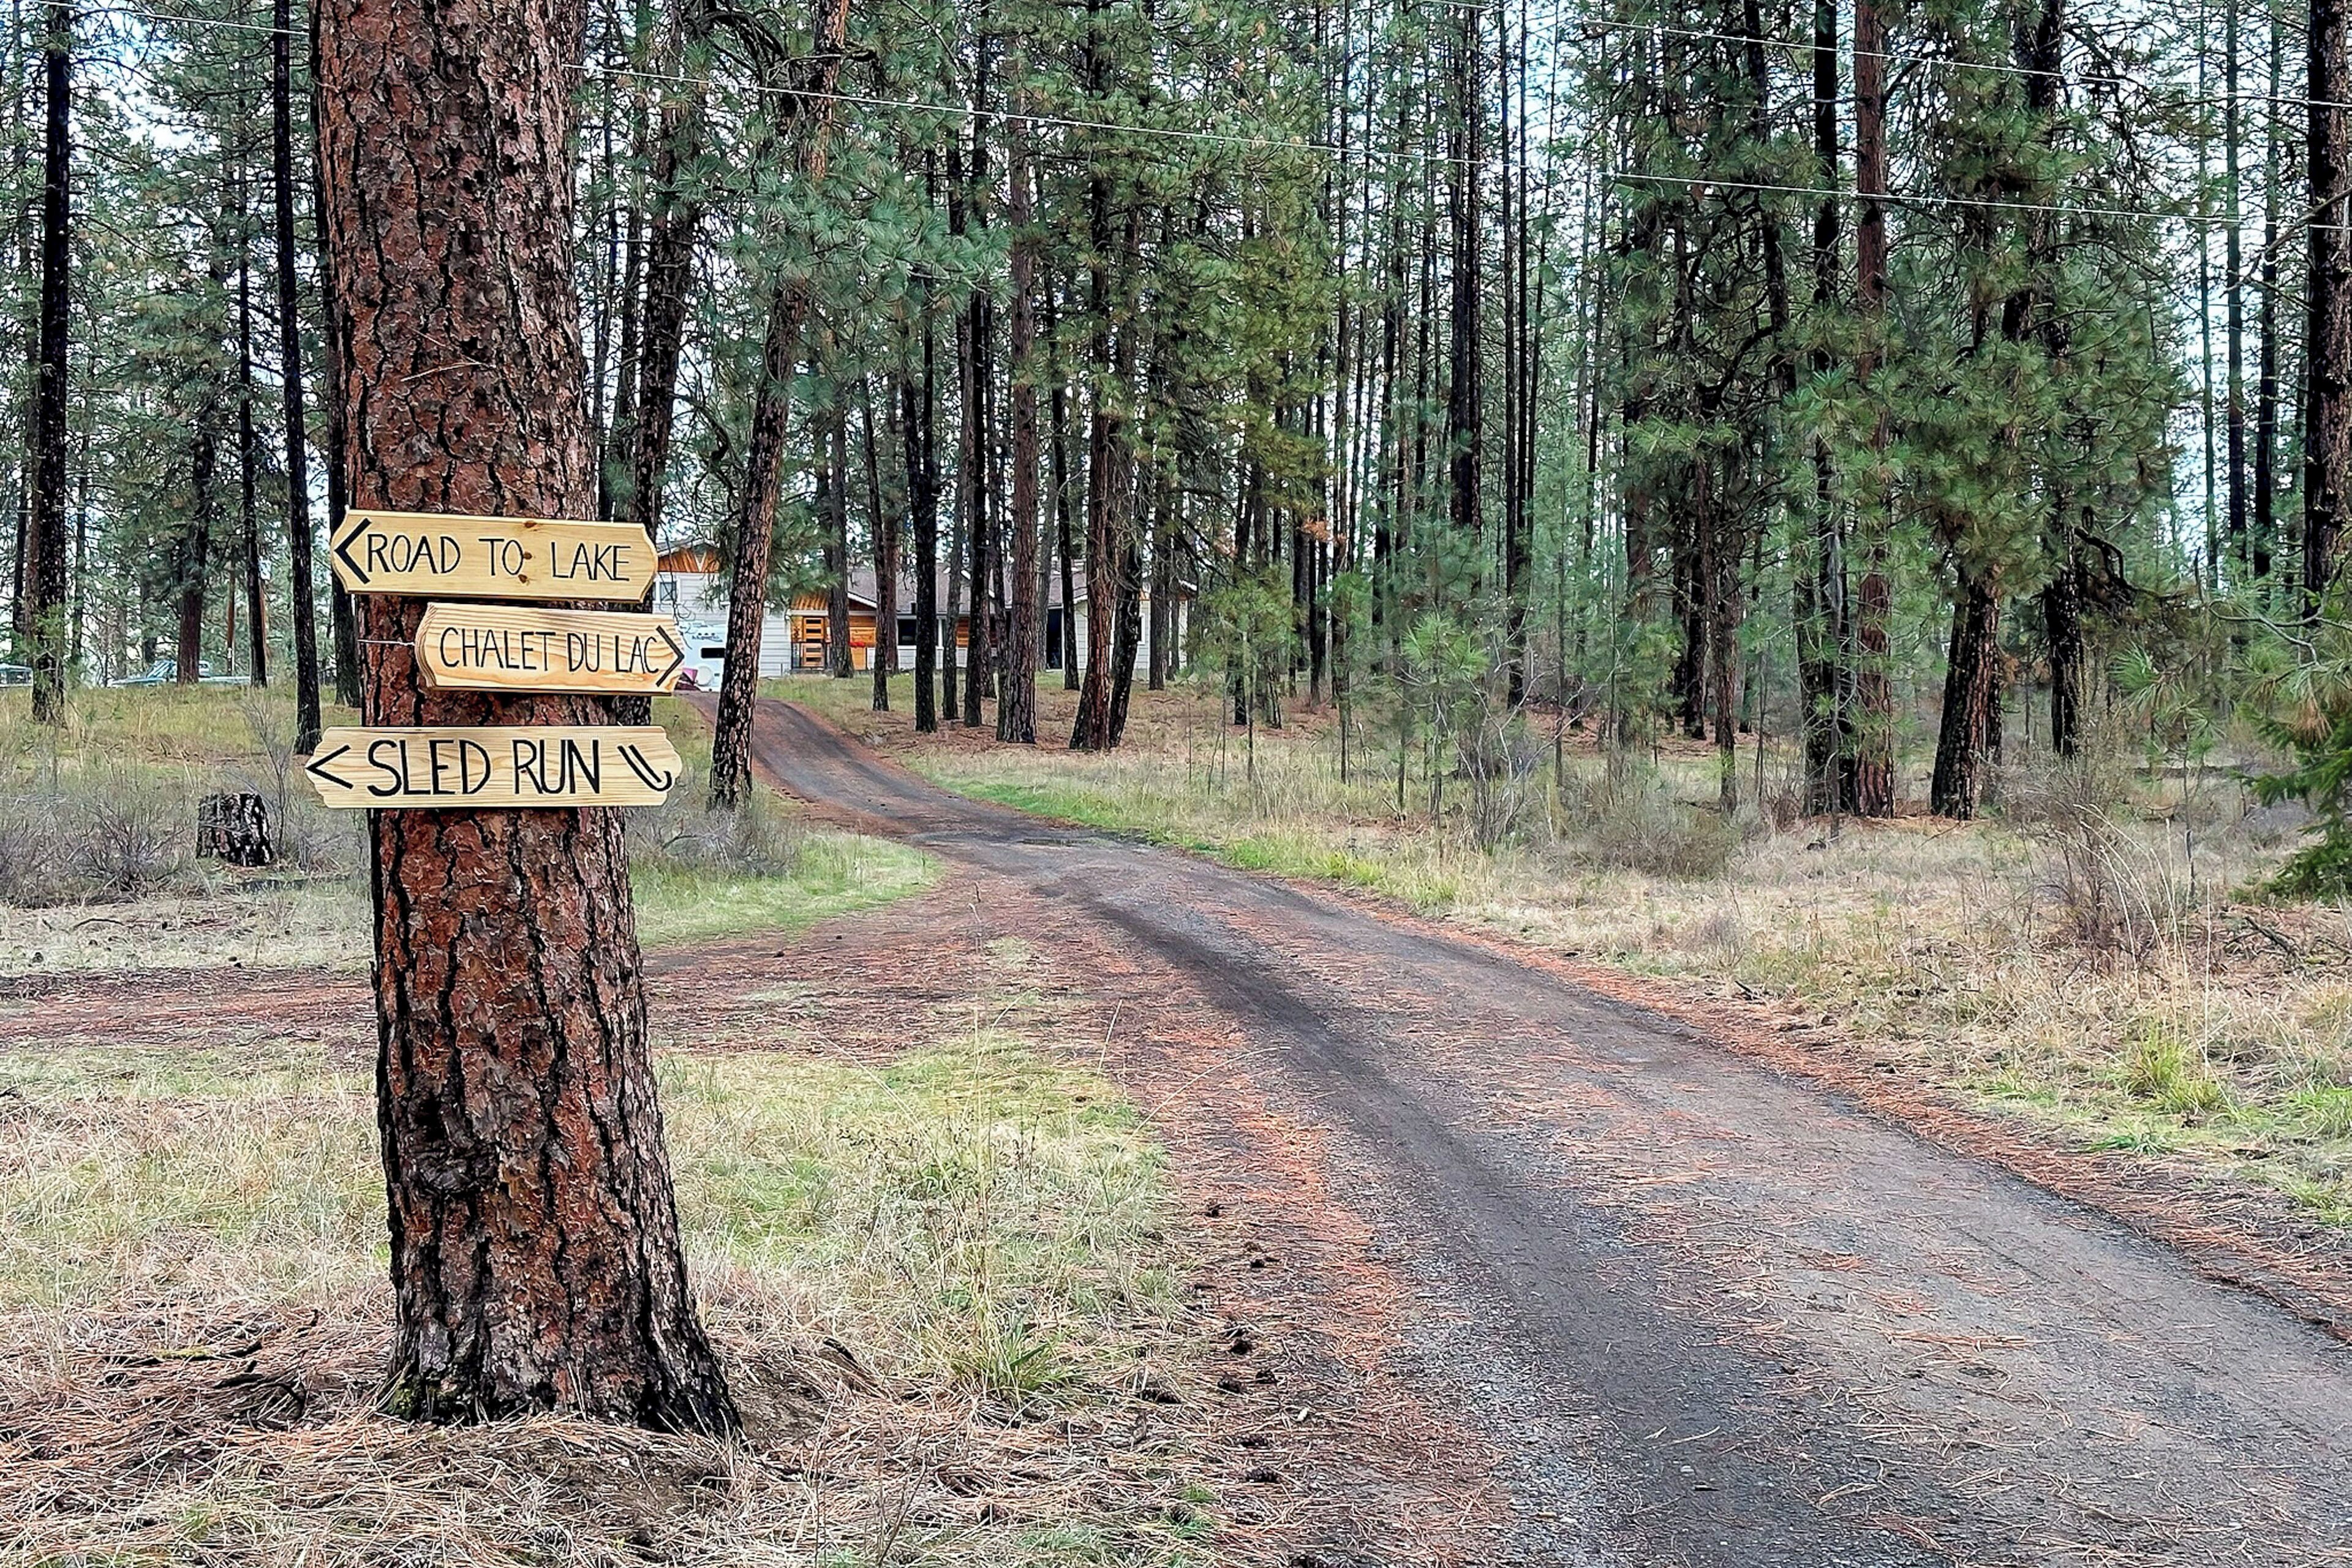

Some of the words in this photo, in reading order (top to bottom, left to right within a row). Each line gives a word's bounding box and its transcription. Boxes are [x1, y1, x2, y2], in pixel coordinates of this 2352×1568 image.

[367, 533, 461, 575] ROAD
[478, 538, 523, 576] TO
[551, 541, 630, 581] LAKE
[439, 627, 556, 672] CHALET
[567, 632, 600, 673] DU
[614, 635, 660, 674] LAC
[367, 739, 491, 797] SLED
[513, 739, 601, 795] RUN
